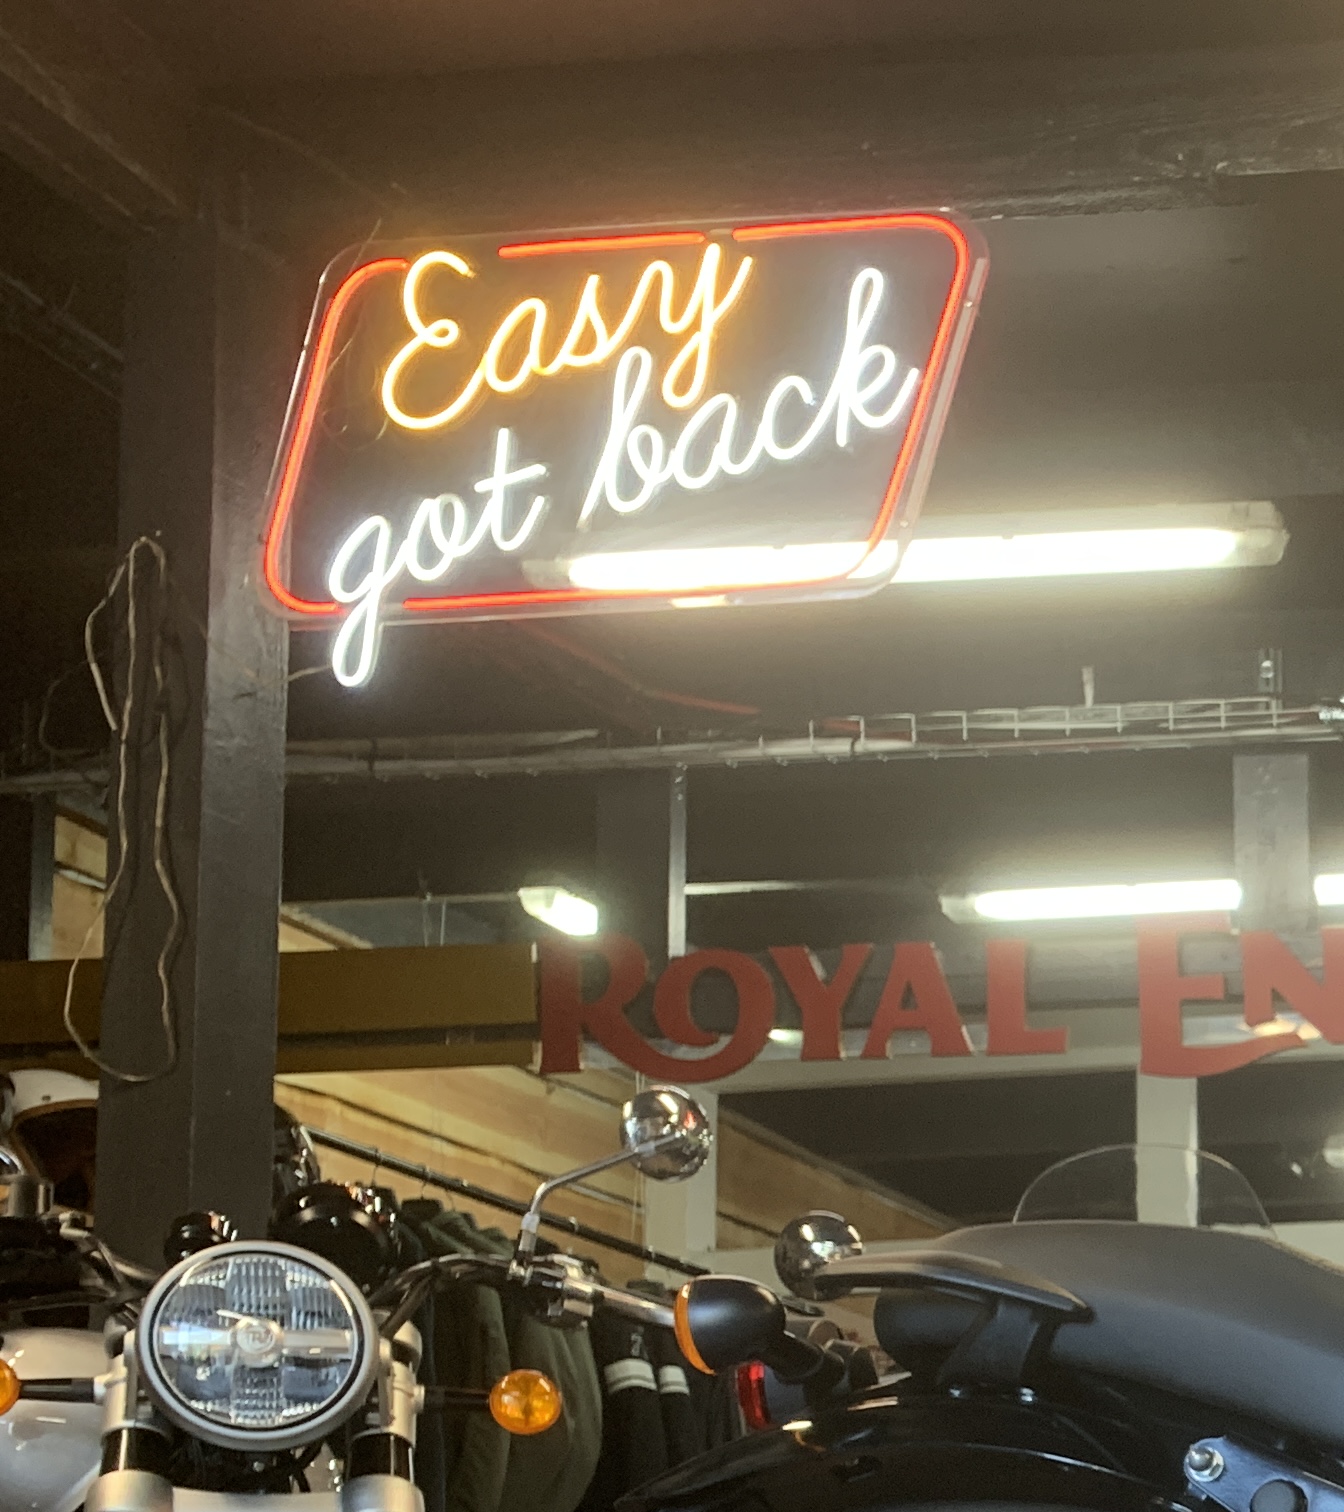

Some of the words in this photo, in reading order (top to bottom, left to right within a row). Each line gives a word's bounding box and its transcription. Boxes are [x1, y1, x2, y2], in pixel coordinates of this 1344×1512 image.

[382, 241, 754, 430] Easy
[327, 428, 548, 687] got
[579, 267, 920, 528] back
[538, 933, 1068, 1083] ROYAL
